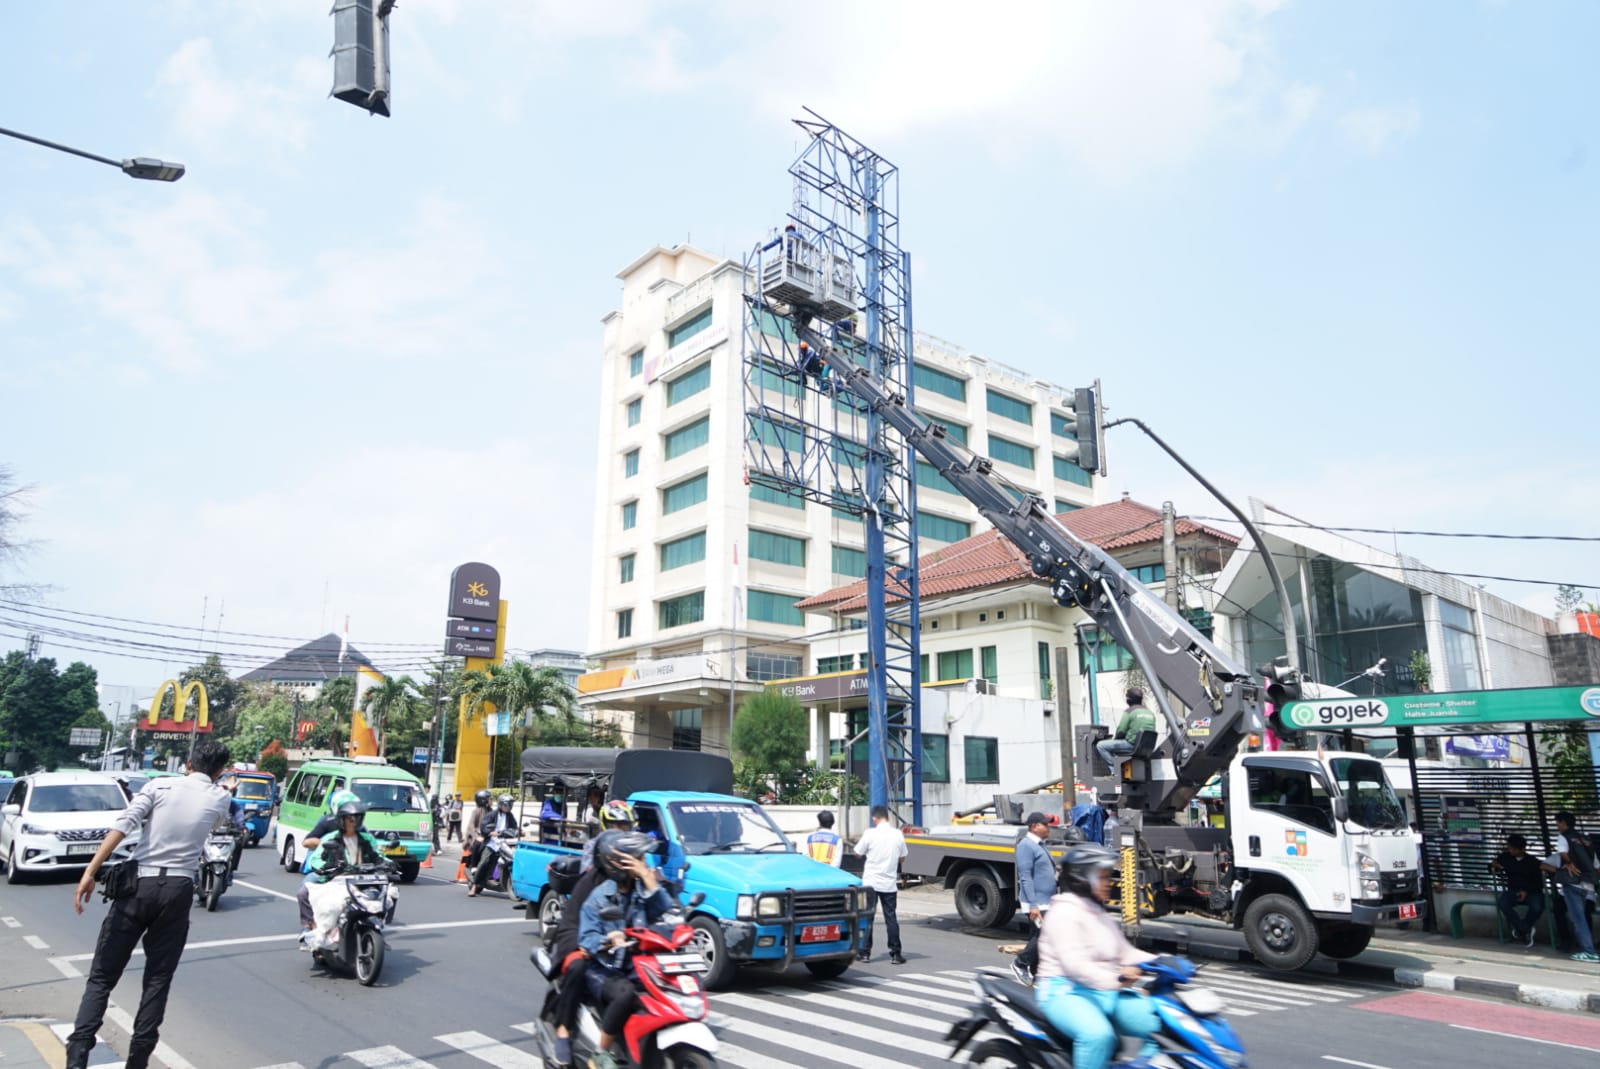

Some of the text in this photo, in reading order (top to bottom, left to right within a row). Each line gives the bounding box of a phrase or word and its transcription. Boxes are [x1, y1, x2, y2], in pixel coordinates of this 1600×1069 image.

[463, 597, 490, 607] KB Bank
[781, 684, 816, 697] KB Bank
[1319, 701, 1383, 724] gojek
